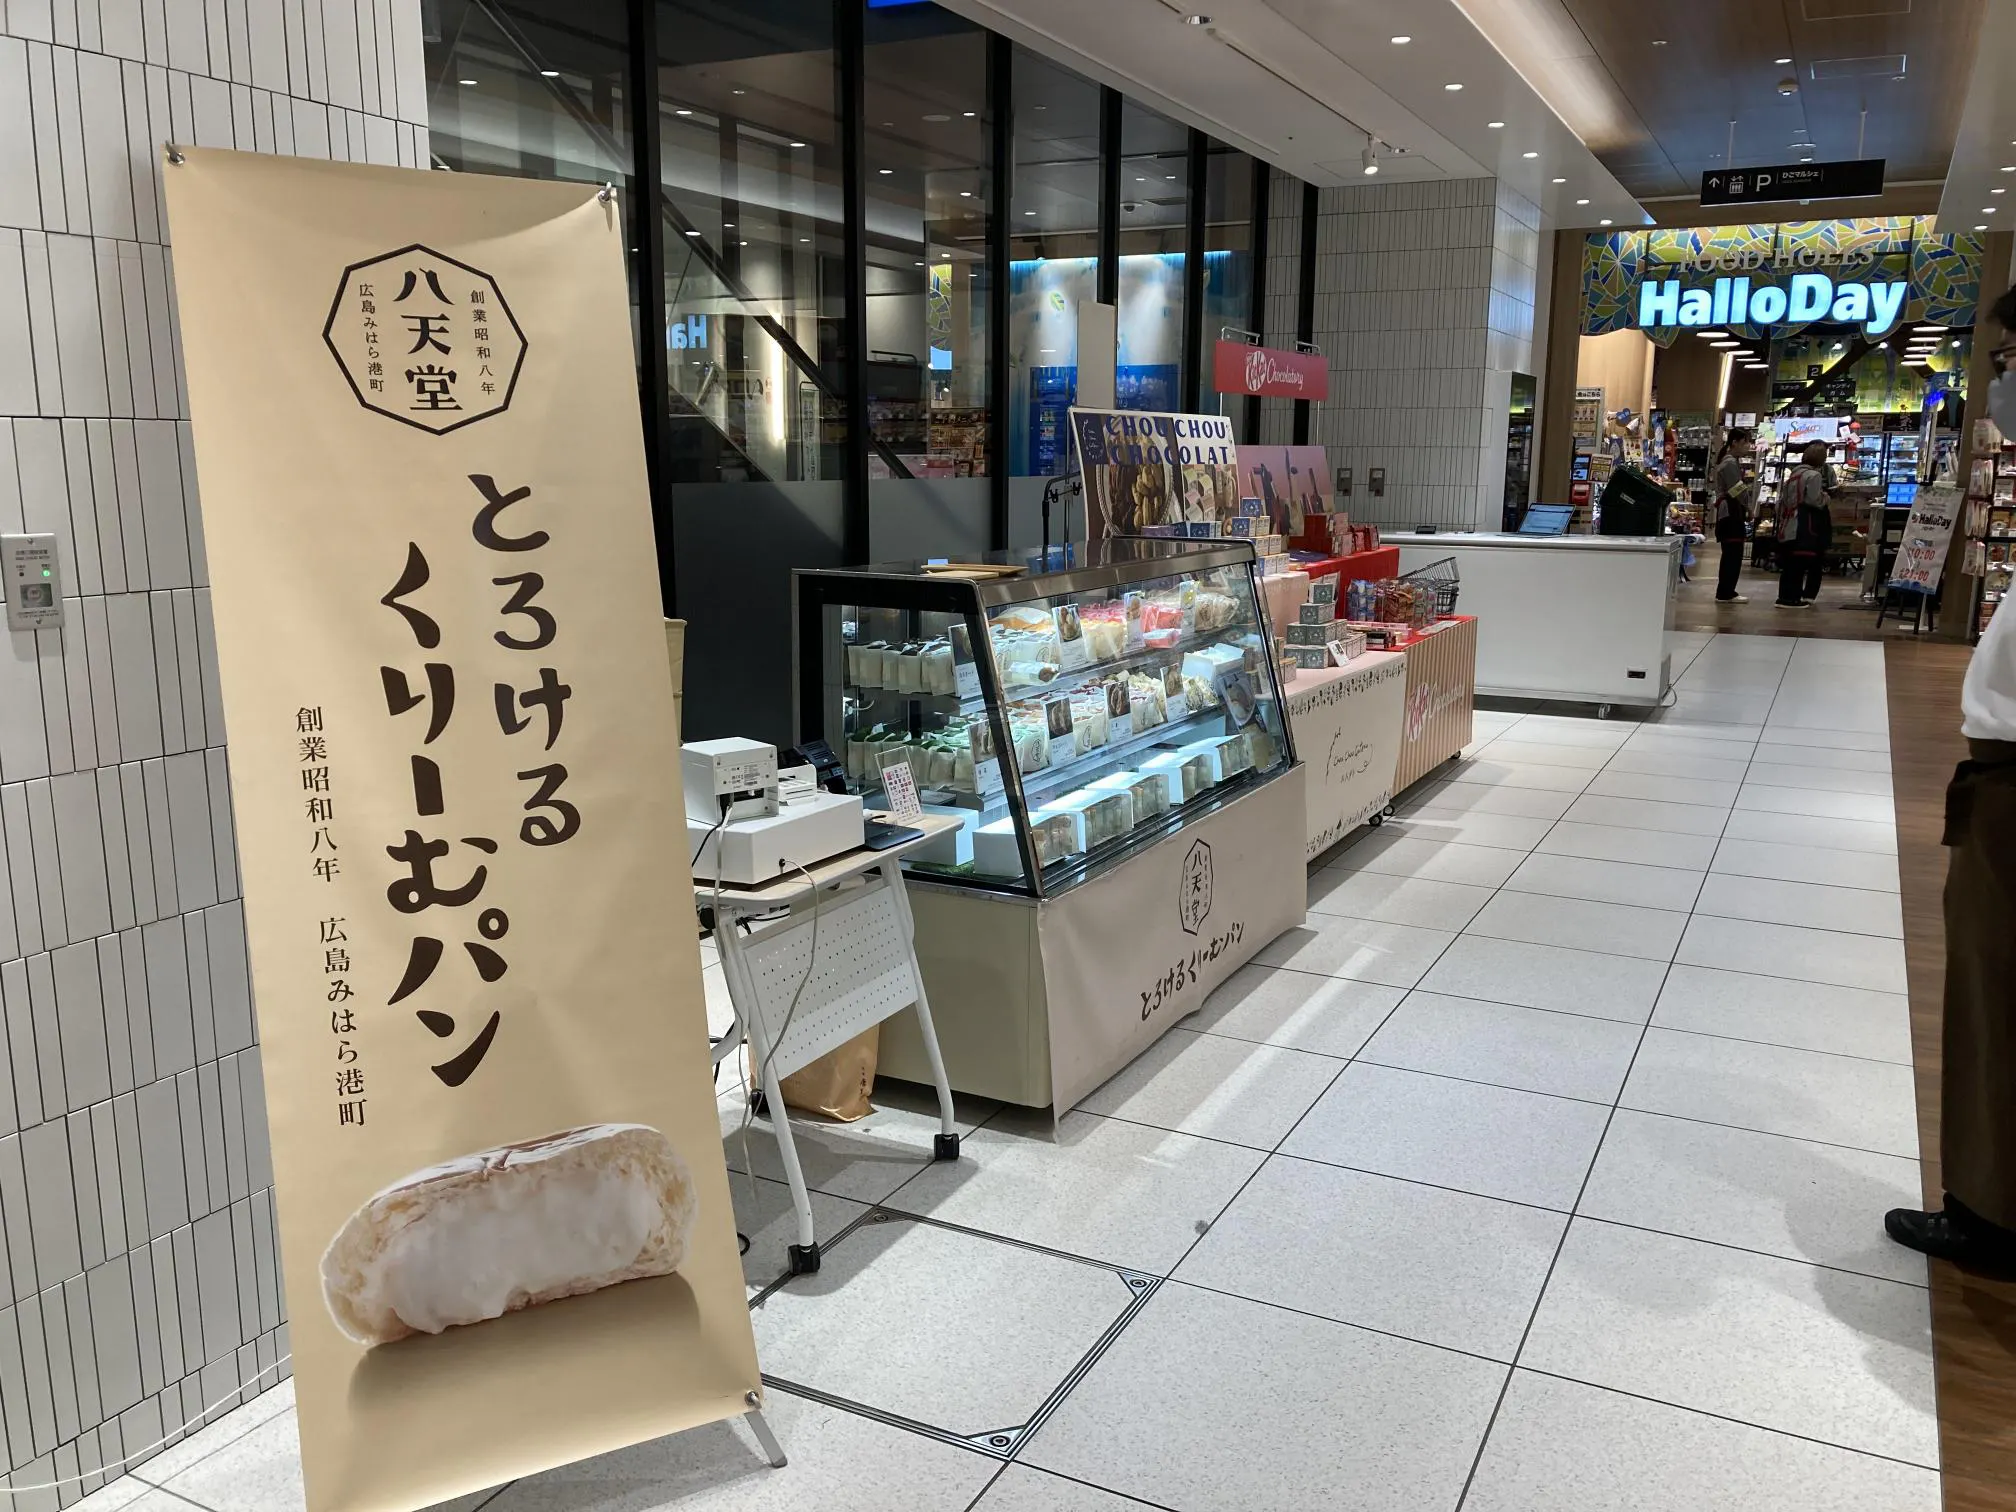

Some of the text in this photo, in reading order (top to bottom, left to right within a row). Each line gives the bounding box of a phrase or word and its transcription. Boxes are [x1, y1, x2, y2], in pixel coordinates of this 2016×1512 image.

[1756, 174, 1772, 192] P
[1678, 250, 1765, 273] FOOD
[359, 283, 384, 392] 広島みはら港町
[392, 267, 464, 410] 八天堂
[1639, 273, 1908, 334] HalloDay
[470, 290, 496, 395] 創業昭和八年
[1811, 367, 1819, 377] 2
[1105, 417, 1226, 439] CHOU CHOU
[1111, 445, 1228, 465] CHOCOLAT
[1918, 513, 1952, 529] HalloDay
[468, 474, 581, 847] とろける
[380, 541, 509, 1088] くりーむパン
[296, 707, 368, 1127] 創業昭和八年 広島みはら港町
[1191, 850, 1203, 926] 八天堂
[1140, 921, 1244, 1021] とろけるくりーむパン
